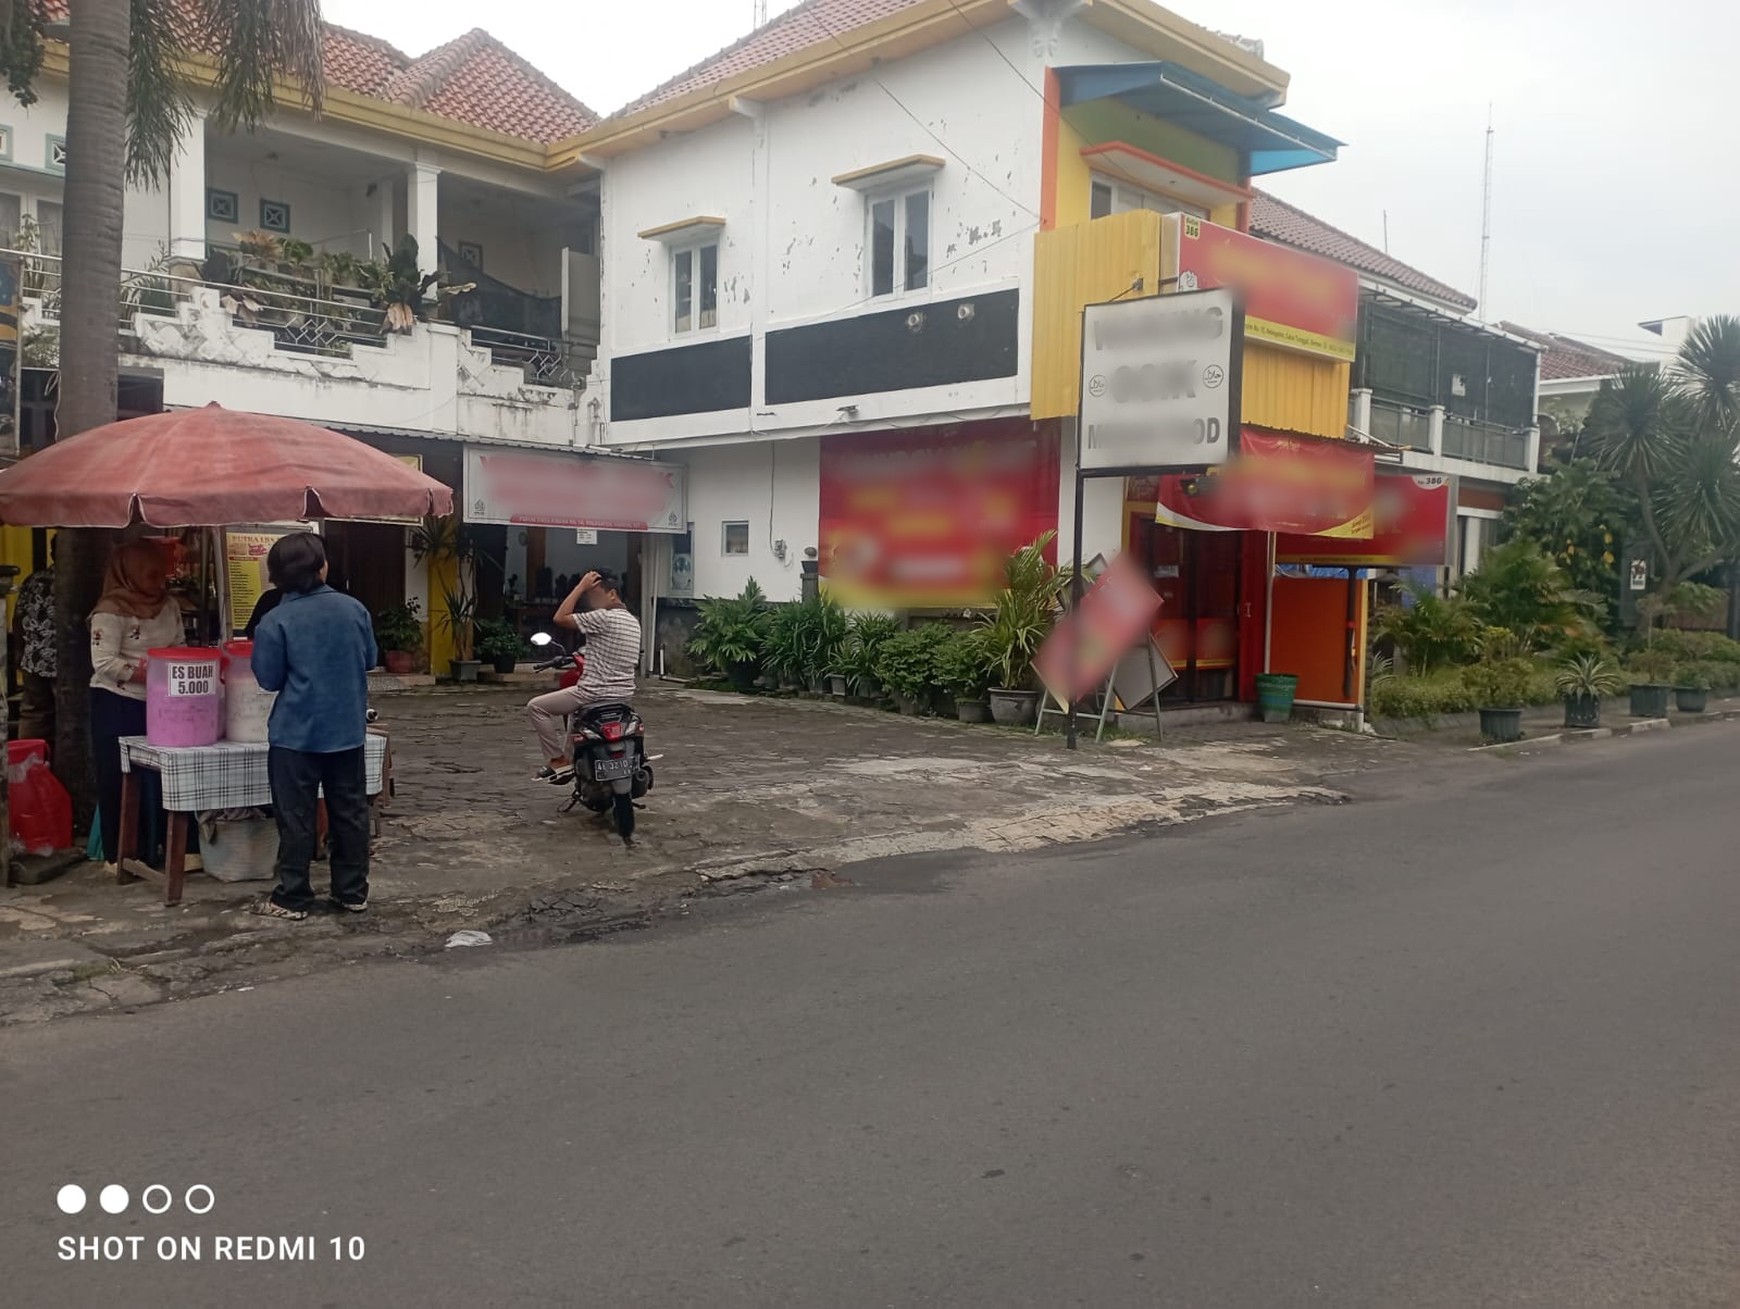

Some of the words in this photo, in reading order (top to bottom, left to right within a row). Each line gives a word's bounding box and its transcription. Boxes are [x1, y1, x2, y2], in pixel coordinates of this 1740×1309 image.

[172, 665, 185, 680] ES
[187, 665, 213, 680] BUAH
[178, 680, 209, 695] 5.000
